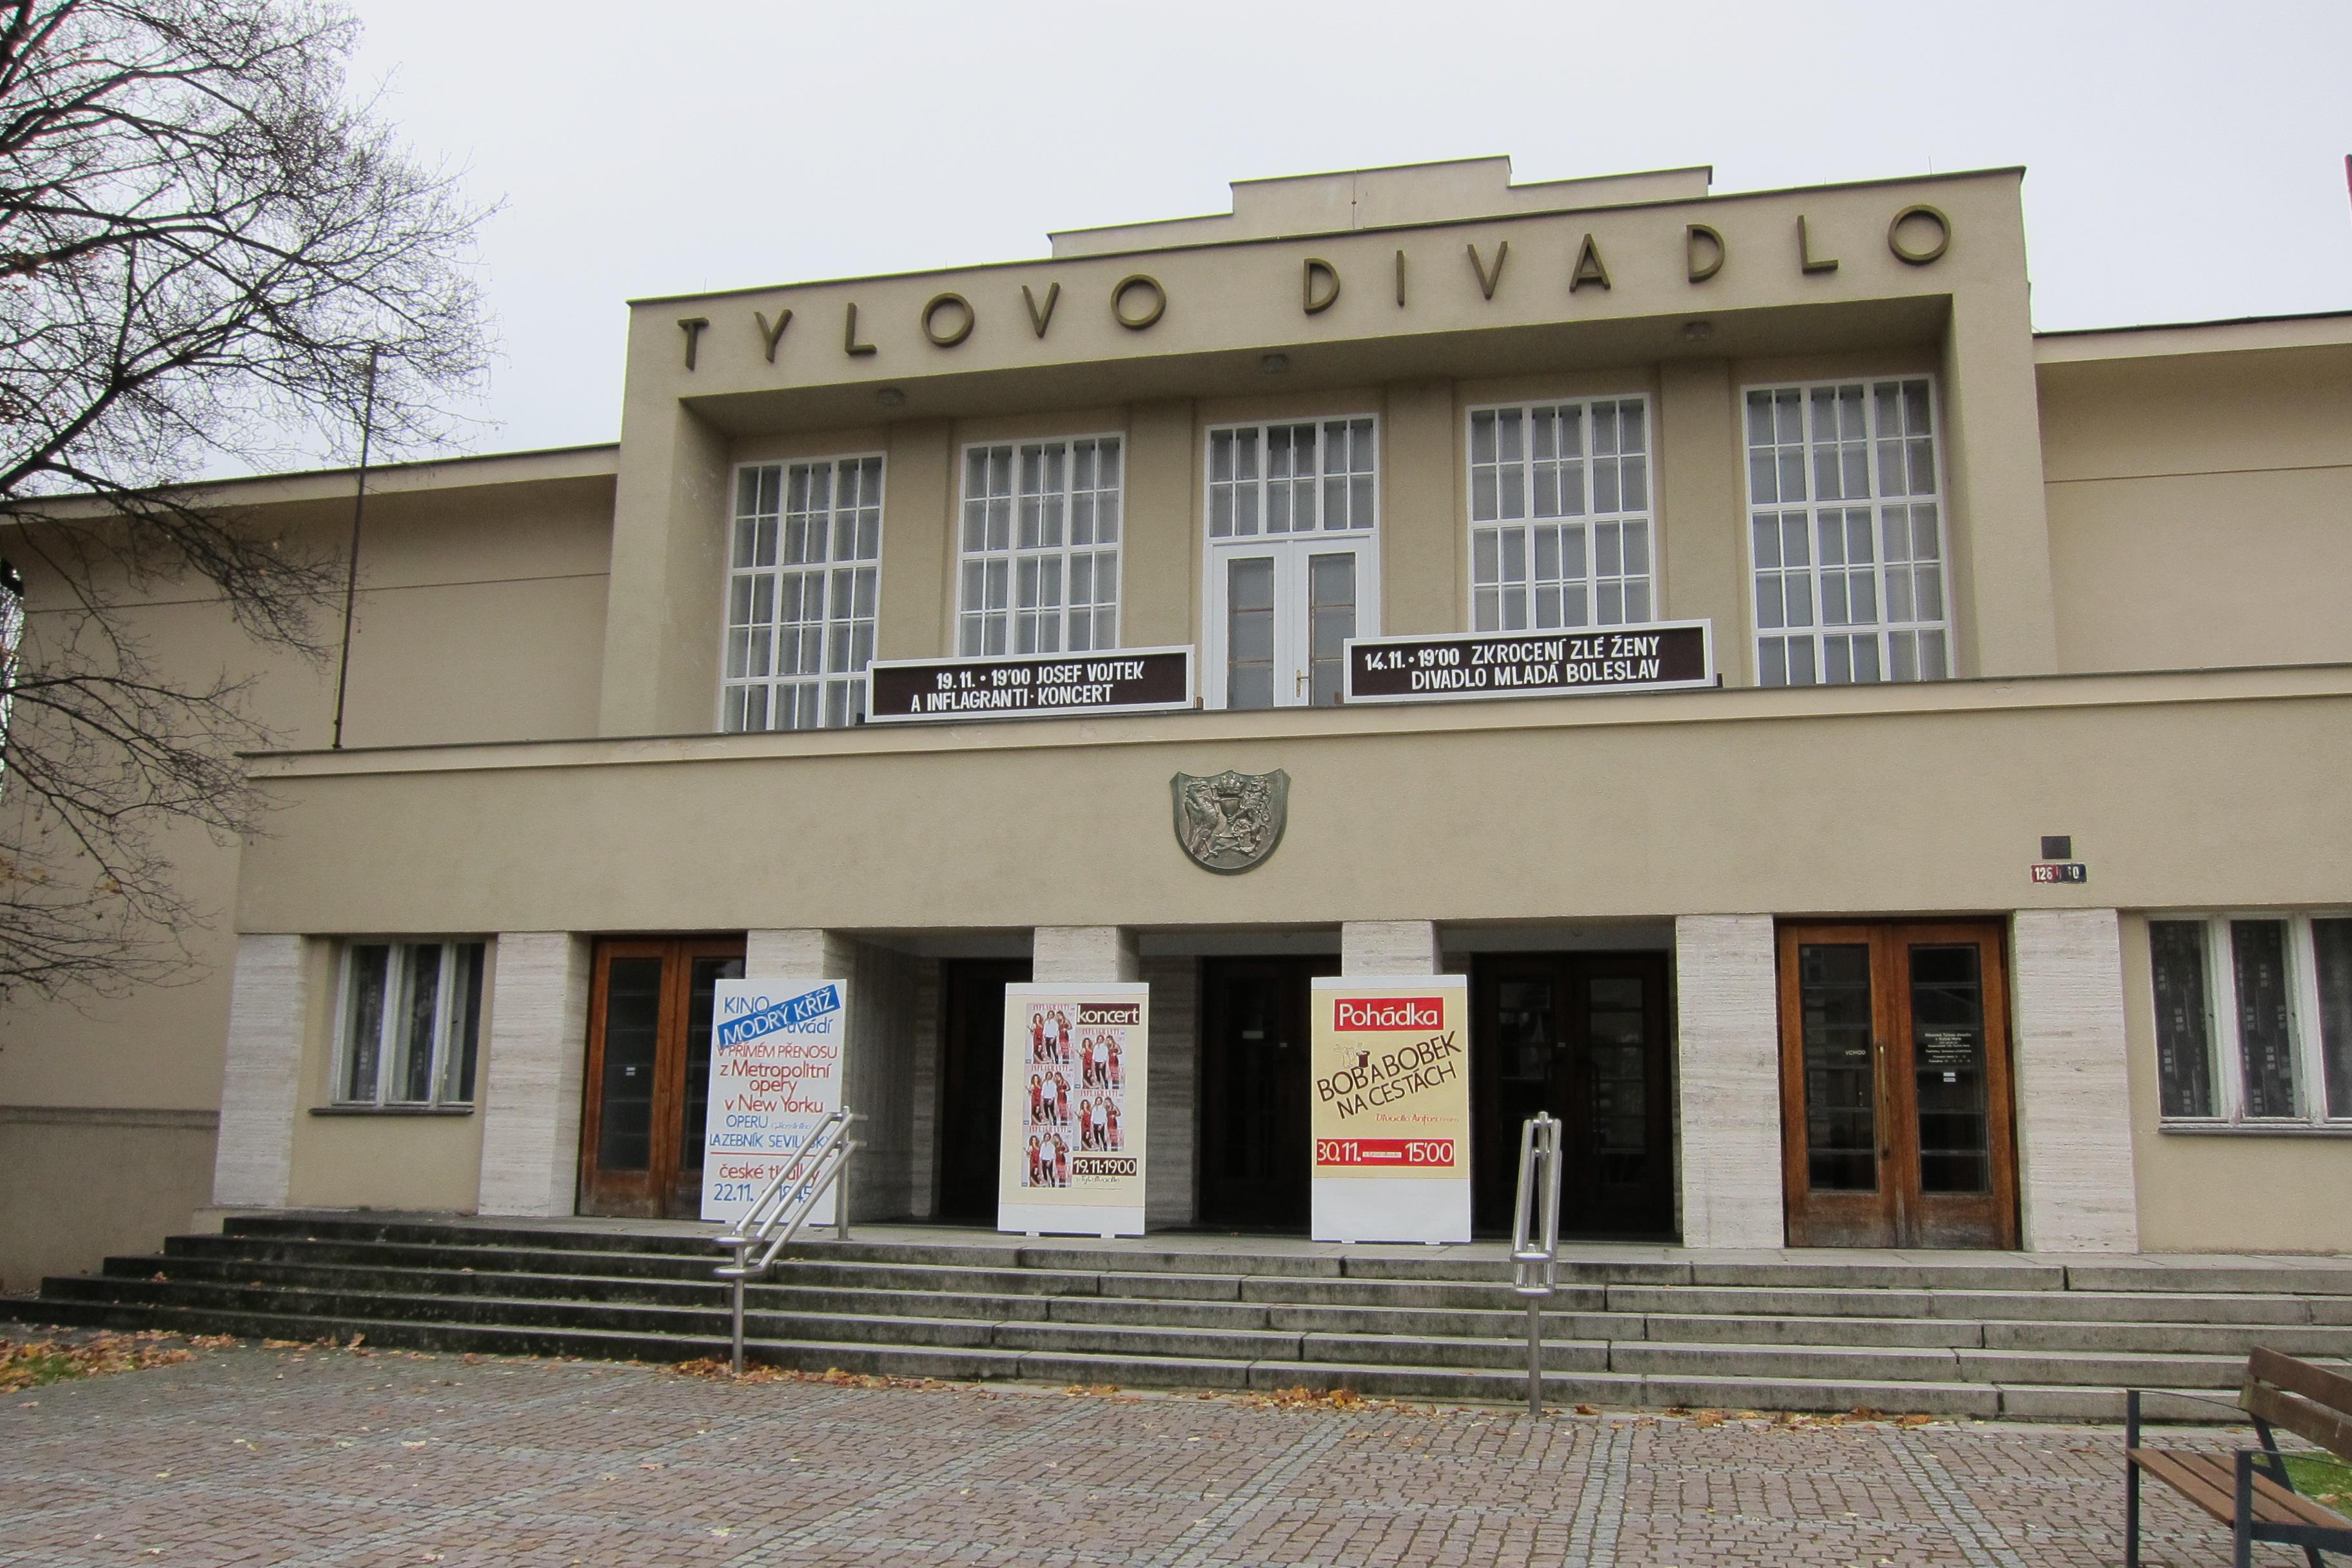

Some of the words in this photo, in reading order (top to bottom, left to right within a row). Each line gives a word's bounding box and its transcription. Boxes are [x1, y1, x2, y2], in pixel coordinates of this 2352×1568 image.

[677, 273, 1166, 371] TYLOVO
[1303, 204, 1952, 315] DIVADLO
[1418, 648, 1460, 667] 19'00
[1471, 639, 1566, 665] ZKROCENÍ
[1571, 636, 1604, 660] ZLÉ
[1611, 635, 1660, 658] ŽENY
[991, 669, 1031, 687] 19'00
[1036, 664, 1082, 685] JOSEF
[1087, 661, 1144, 683] VOJTEK
[1411, 668, 1486, 689] DIVADLO
[1494, 661, 1558, 686] MLADÁ
[1567, 660, 1660, 683] BOLESLAV
[911, 694, 921, 712] A
[927, 689, 1028, 712] INFLAGRANTI
[1038, 684, 1113, 706] KONCERT
[723, 995, 770, 1014] KINO
[1077, 1004, 1139, 1024] koncert
[1339, 1003, 1438, 1026] Pohádka
[723, 1004, 789, 1045] MODRÝ
[794, 988, 835, 1020] KŘÍŽ
[787, 1017, 833, 1034] uvádí
[729, 1041, 775, 1058] PŘÍMÉM
[778, 1043, 838, 1059] PŘENOSU
[720, 1064, 728, 1076] z
[731, 1059, 832, 1081] Metropolitní
[1317, 1066, 1369, 1102] BOB
[1371, 1064, 1385, 1084] A
[1382, 1030, 1462, 1077] BOBEK
[749, 1079, 798, 1097] opery
[1337, 1093, 1368, 1119] NA
[1369, 1061, 1457, 1106] CESTÁCH
[725, 1099, 734, 1111] v
[738, 1093, 777, 1112] New
[780, 1095, 823, 1113] Yorku
[726, 1114, 769, 1128] OPERU
[709, 1132, 764, 1148] LAZEBNÍK
[1318, 1141, 1362, 1162] 30.11.
[1405, 1142, 1453, 1162] 15'00
[719, 1162, 764, 1179] české
[714, 1183, 754, 1202] 22.11.
